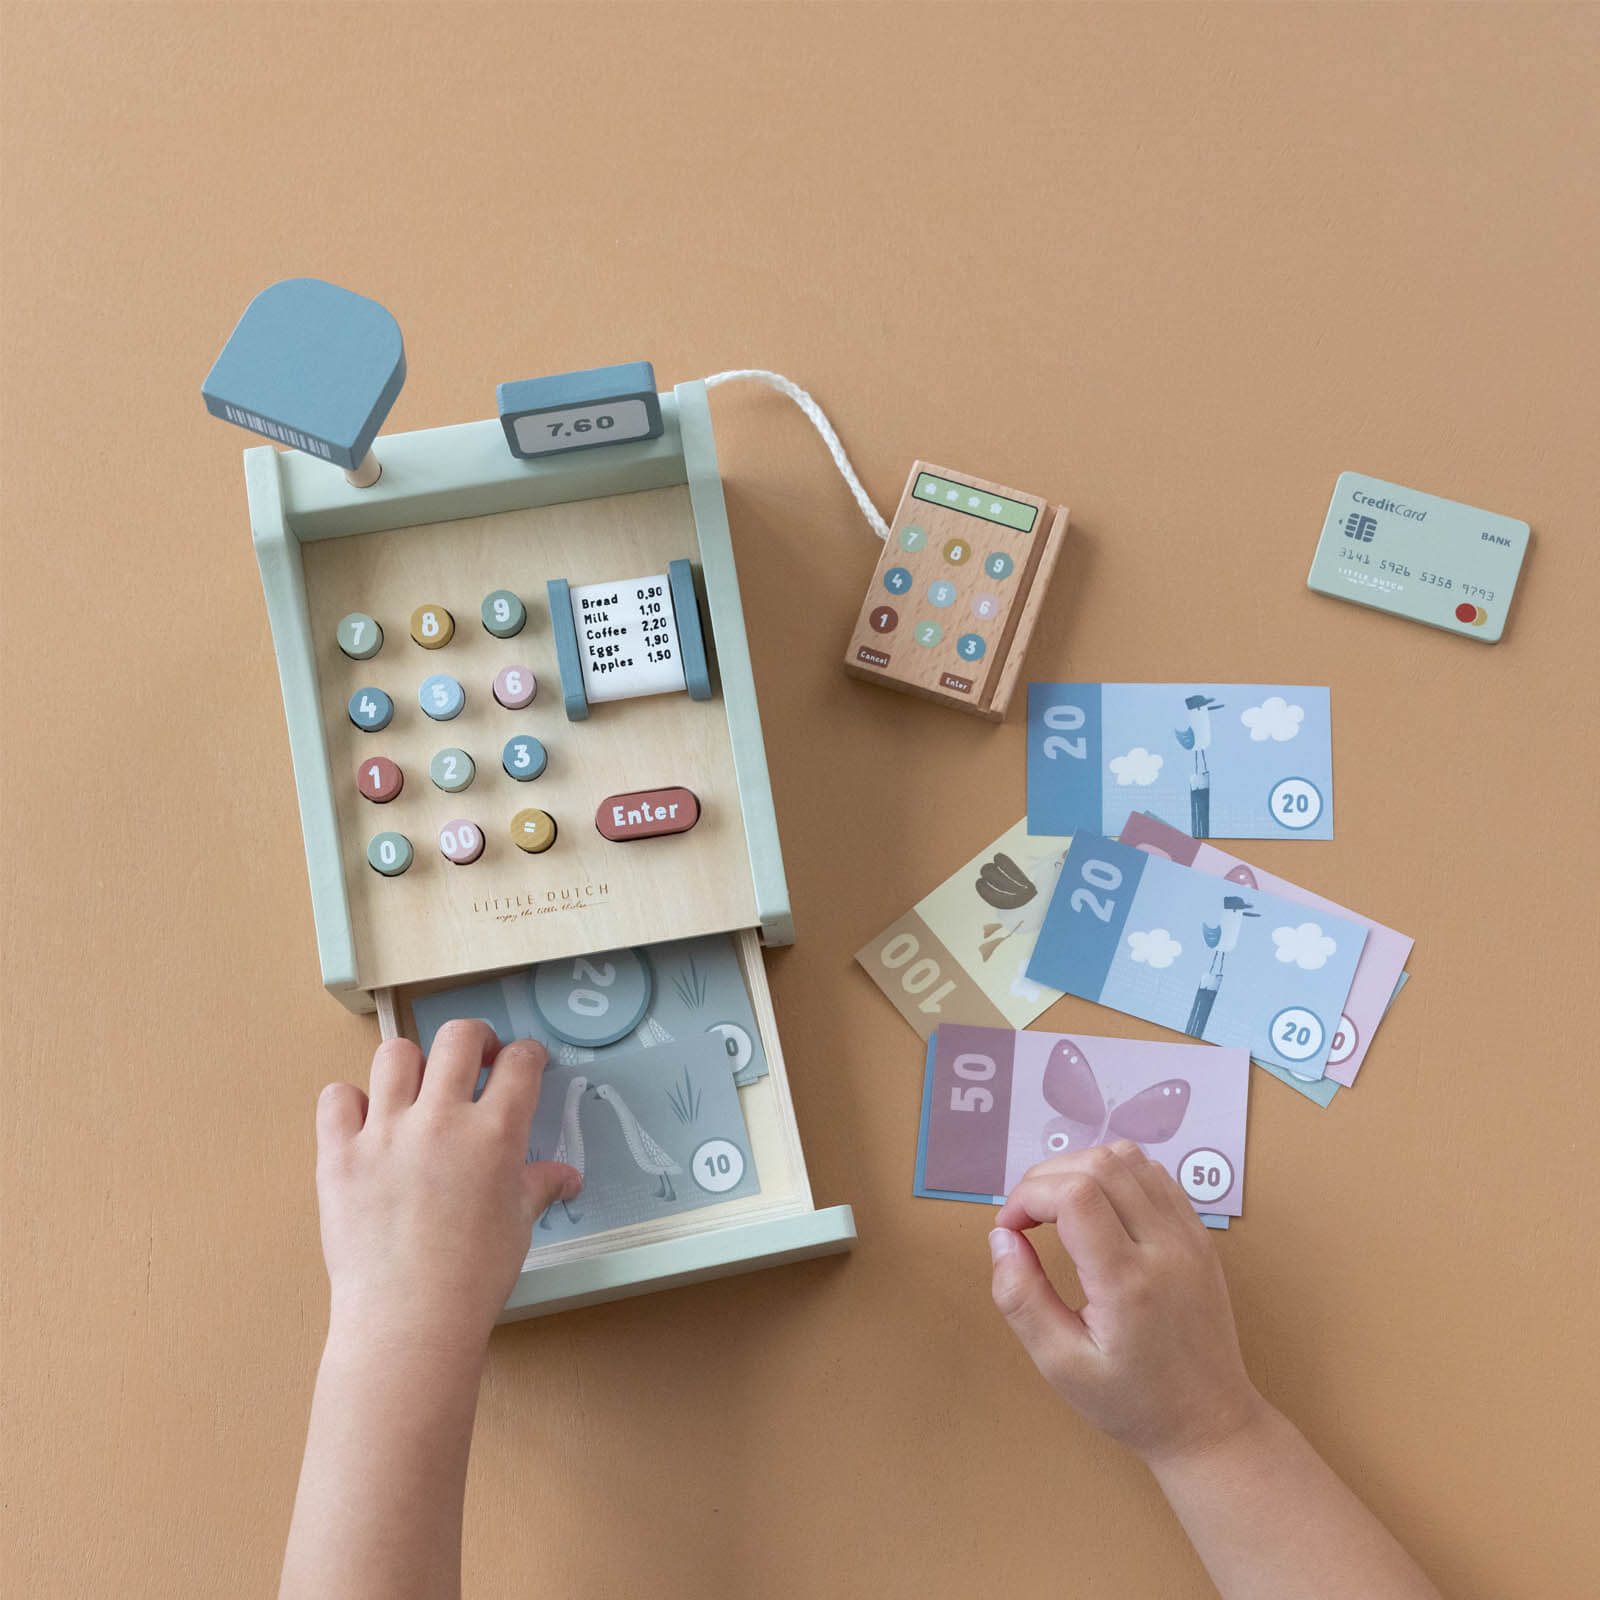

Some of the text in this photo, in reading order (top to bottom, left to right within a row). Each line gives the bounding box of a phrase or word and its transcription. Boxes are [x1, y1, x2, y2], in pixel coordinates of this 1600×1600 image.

[546, 416, 614, 436] 7.60
[1352, 491, 1428, 522] CreditCard
[906, 532, 918, 545] 7
[1481, 532, 1512, 548] BANK
[950, 545, 962, 560] 8
[992, 559, 1004, 574] 9
[1338, 547, 1370, 565] 3141
[1379, 559, 1411, 577] 5926
[1420, 571, 1453, 590] 5358
[892, 573, 904, 588] 4
[582, 594, 618, 610] Bread
[936, 587, 948, 602] 5
[493, 598, 510, 623] 9
[584, 612, 609, 624] Milk
[978, 600, 992, 616] 6
[421, 612, 438, 637] 8
[879, 614, 889, 628] 1
[350, 622, 365, 646] 7
[586, 626, 627, 640] Coffee
[922, 628, 934, 642] 2
[589, 644, 620, 658] Eggs
[860, 650, 888, 665] Cancel
[964, 640, 977, 656] 3
[592, 657, 634, 674] Apples
[504, 671, 522, 695] 6
[945, 676, 968, 690] Enter
[432, 683, 450, 708] 5
[360, 696, 377, 720] 4
[1043, 704, 1087, 760] 20
[514, 744, 530, 768] 3
[368, 765, 380, 790] 1
[442, 756, 458, 780] 2
[612, 802, 678, 827] Enter
[1282, 794, 1310, 814] 20
[440, 825, 476, 854] 00
[380, 840, 396, 864] 0
[472, 882, 609, 912] LITTLE DUTCH
[1070, 858, 1124, 922] 20
[880, 933, 958, 1013] 100
[568, 958, 616, 1017] 20
[1281, 1020, 1311, 1046] 20
[950, 1052, 997, 1113] 50
[704, 1154, 730, 1177] 10
[1192, 1166, 1220, 1187] 50
